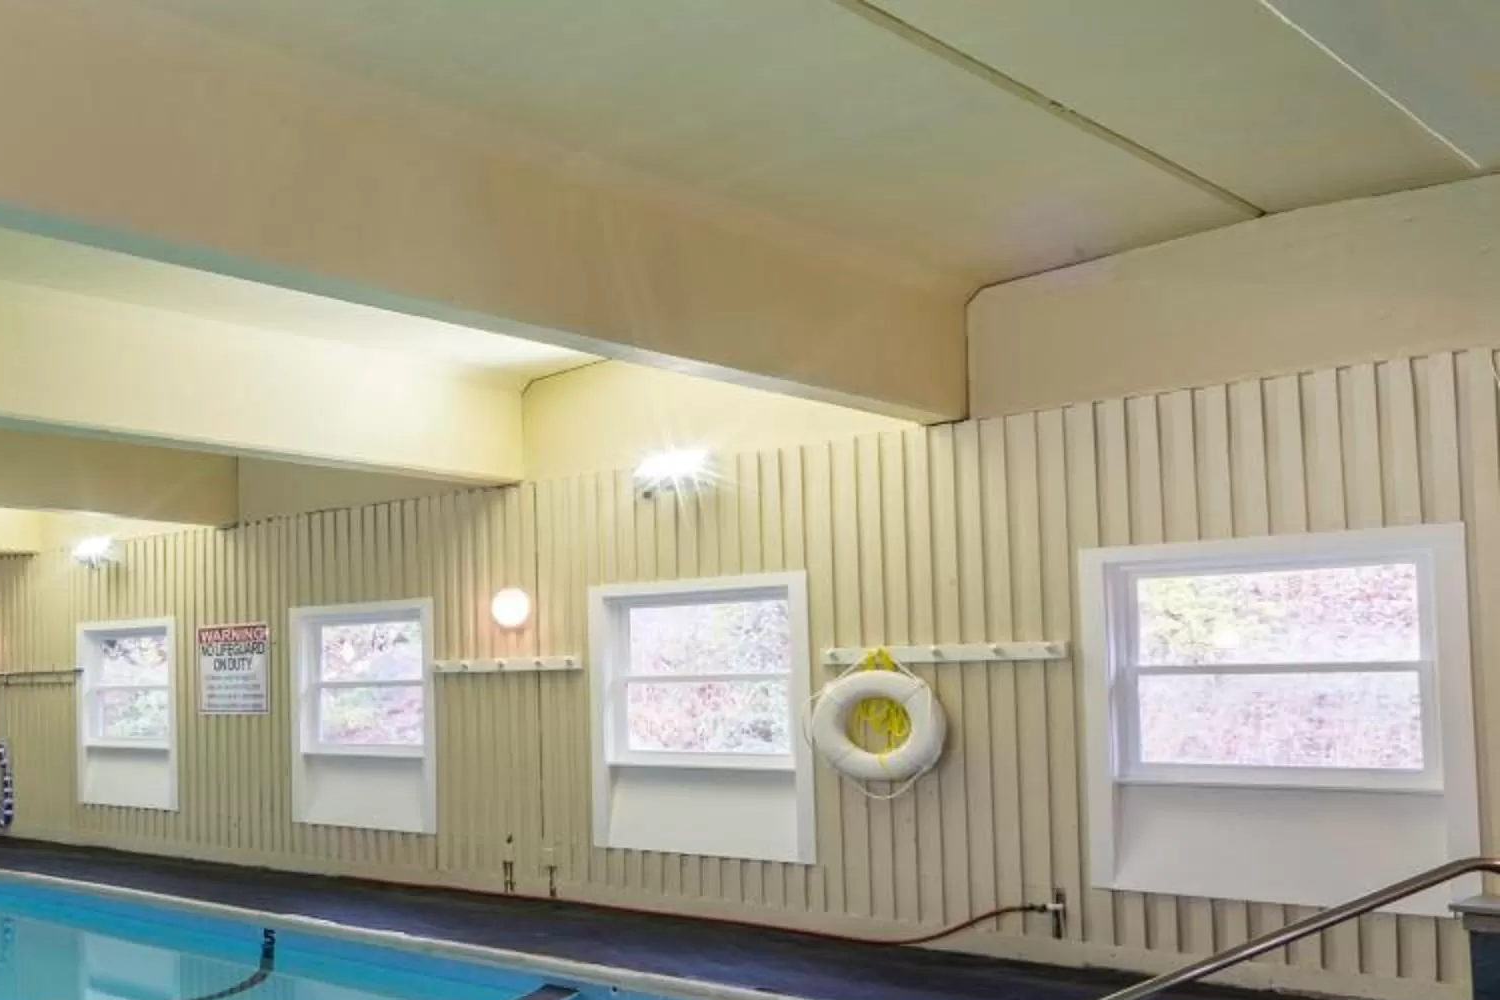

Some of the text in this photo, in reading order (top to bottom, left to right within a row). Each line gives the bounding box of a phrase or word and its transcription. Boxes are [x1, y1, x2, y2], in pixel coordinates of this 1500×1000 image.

[213, 657, 252, 671] ON DUTY
[263, 928, 276, 944] 5
